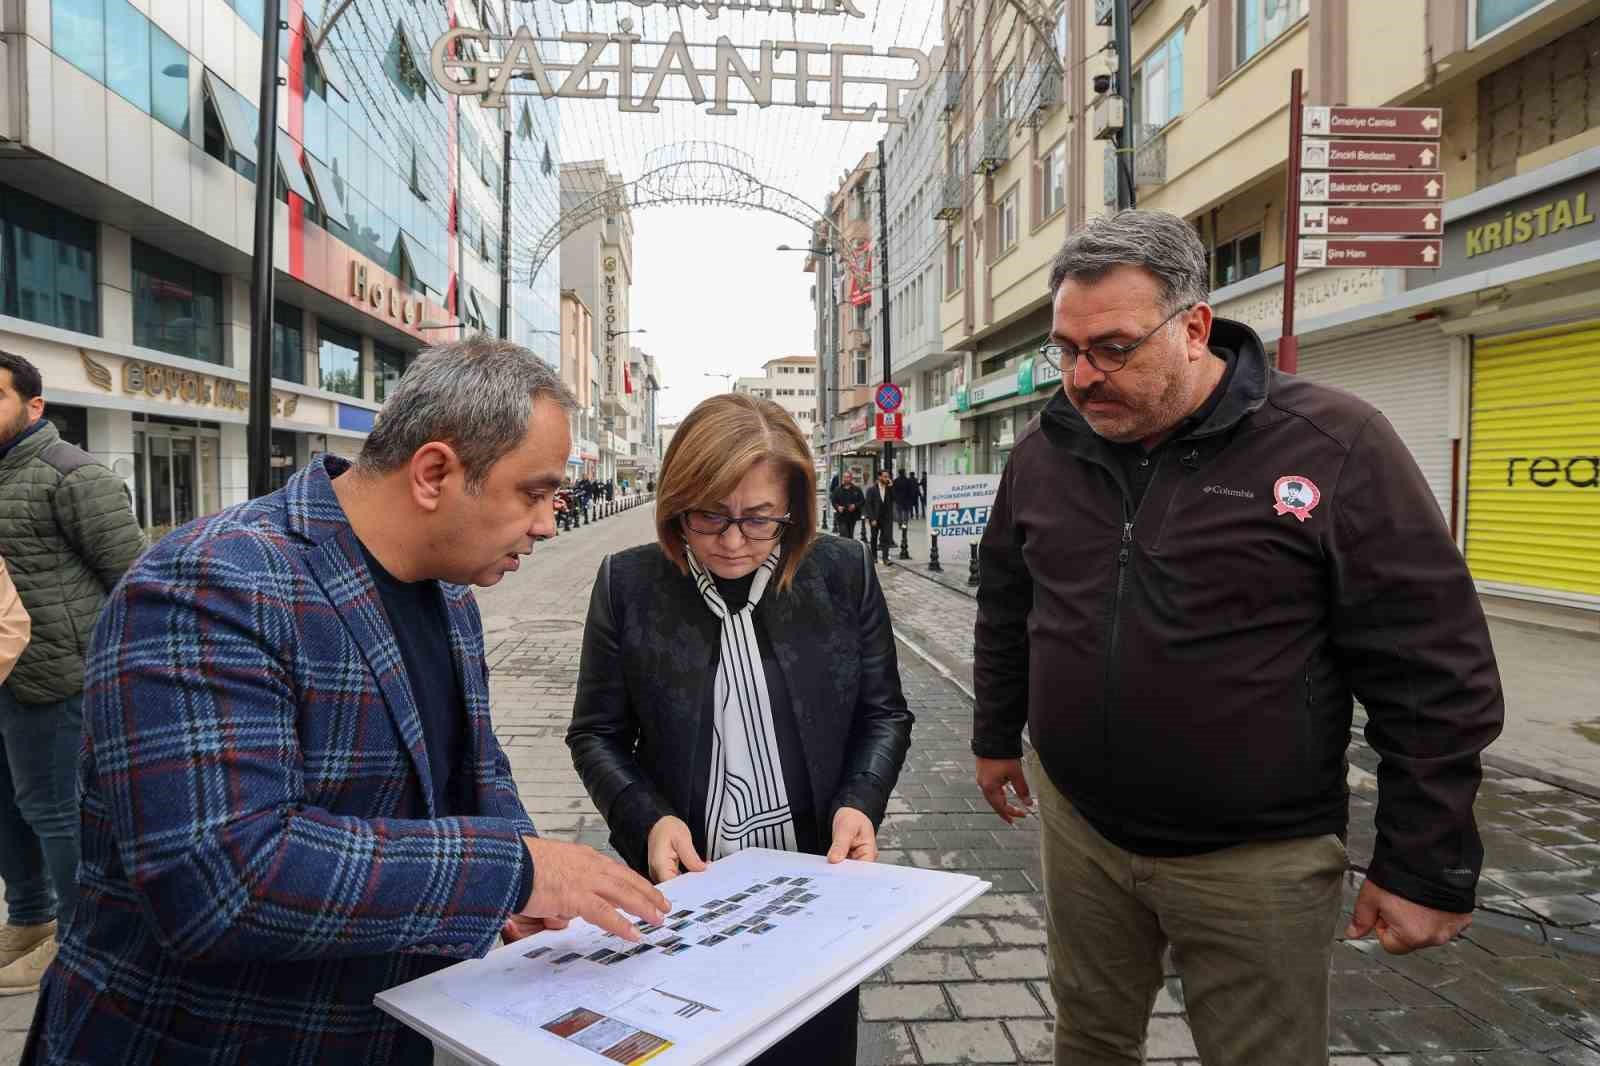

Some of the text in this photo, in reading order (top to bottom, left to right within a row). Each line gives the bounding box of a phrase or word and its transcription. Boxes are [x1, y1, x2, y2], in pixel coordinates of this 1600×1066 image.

[431, 17, 930, 124] GAZİANTEP
[1329, 215, 1349, 225] Kale
[1466, 192, 1594, 258] KRİSTAL
[350, 259, 430, 332] Hotel
[1212, 485, 1255, 498] Columbia
